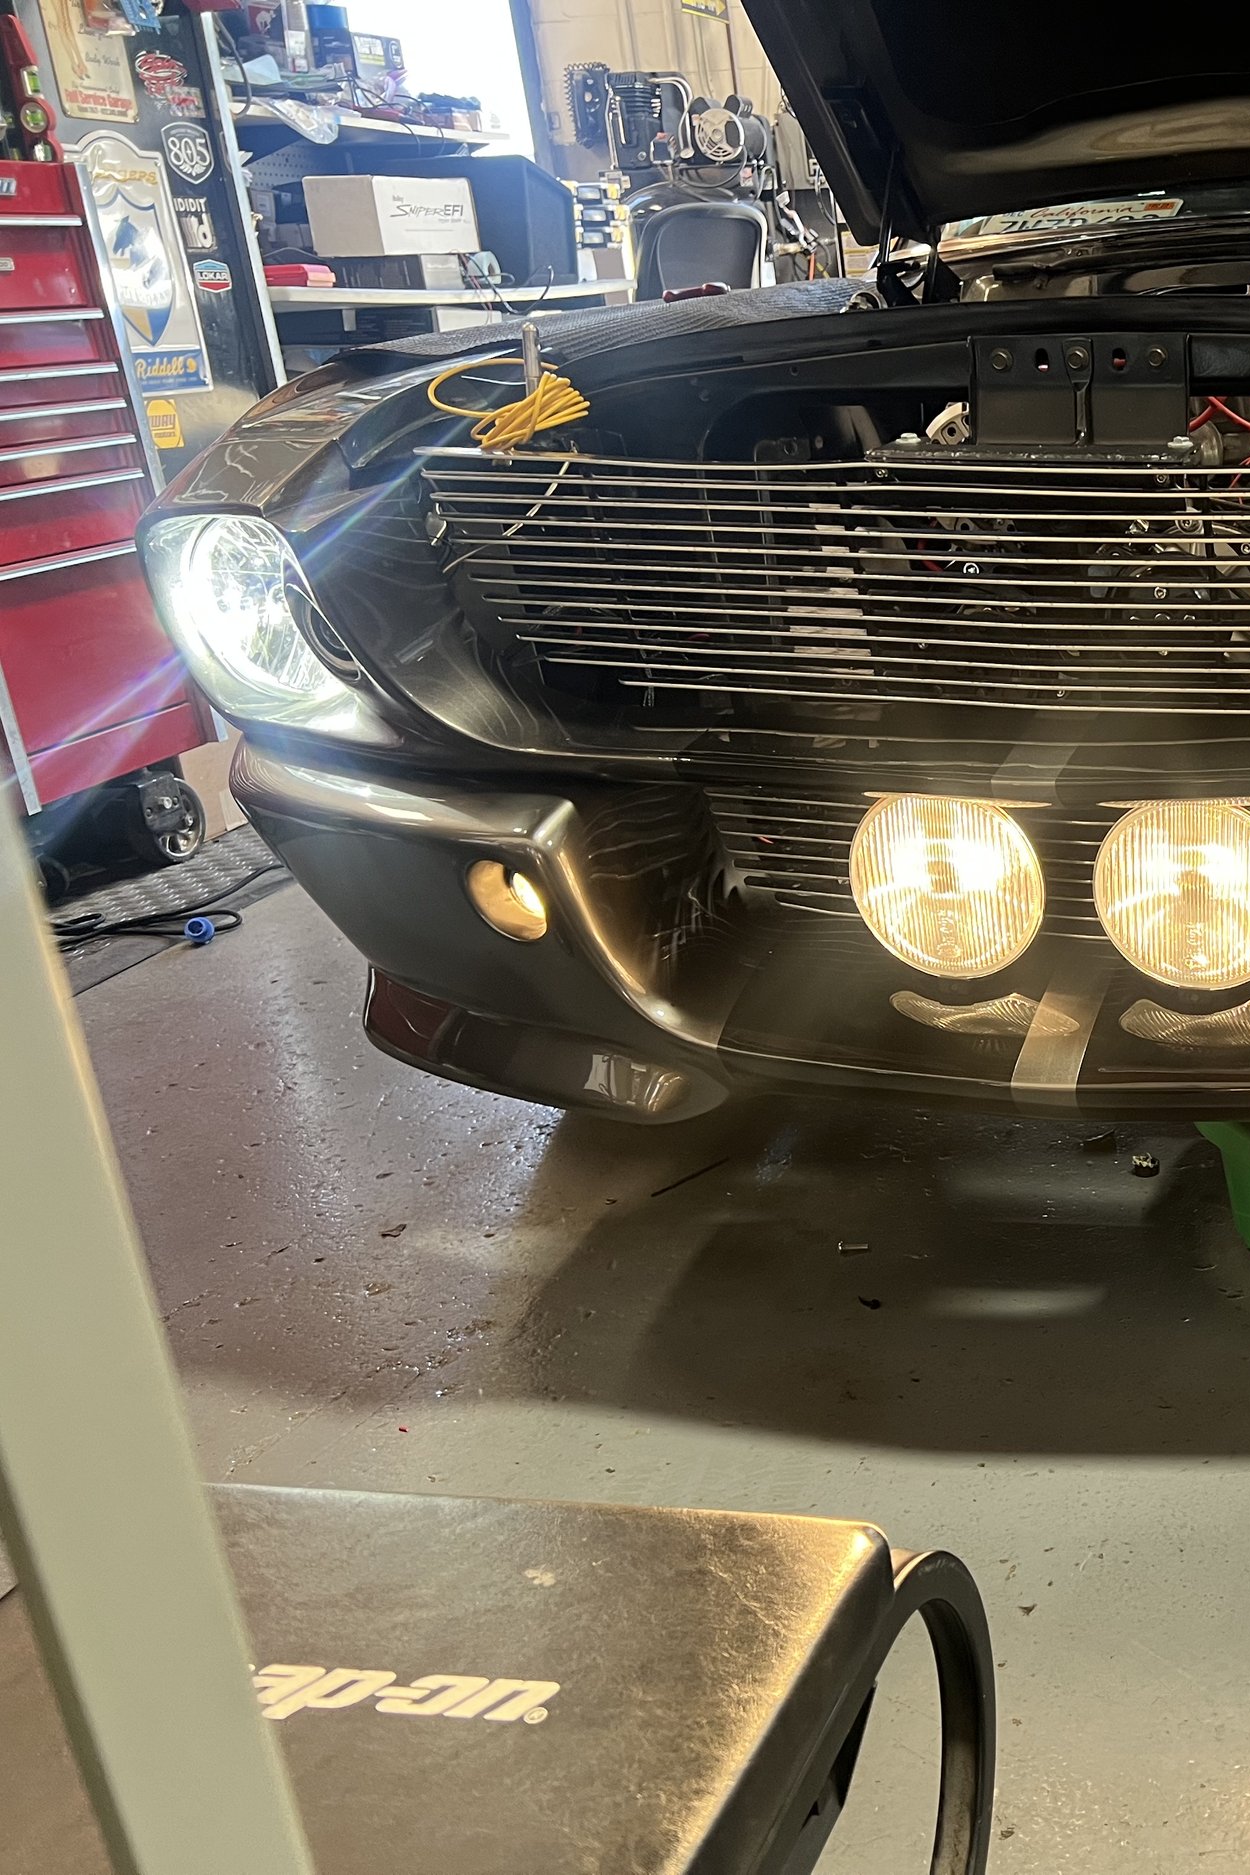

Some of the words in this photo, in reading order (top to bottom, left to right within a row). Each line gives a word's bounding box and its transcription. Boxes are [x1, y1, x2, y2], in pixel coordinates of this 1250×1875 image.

[167, 137, 210, 166] 805
[1031, 204, 1146, 220] California
[197, 271, 229, 280] LOKAR
[135, 356, 185, 379] Riddell
[250, 1663, 561, 1721] ap-on
